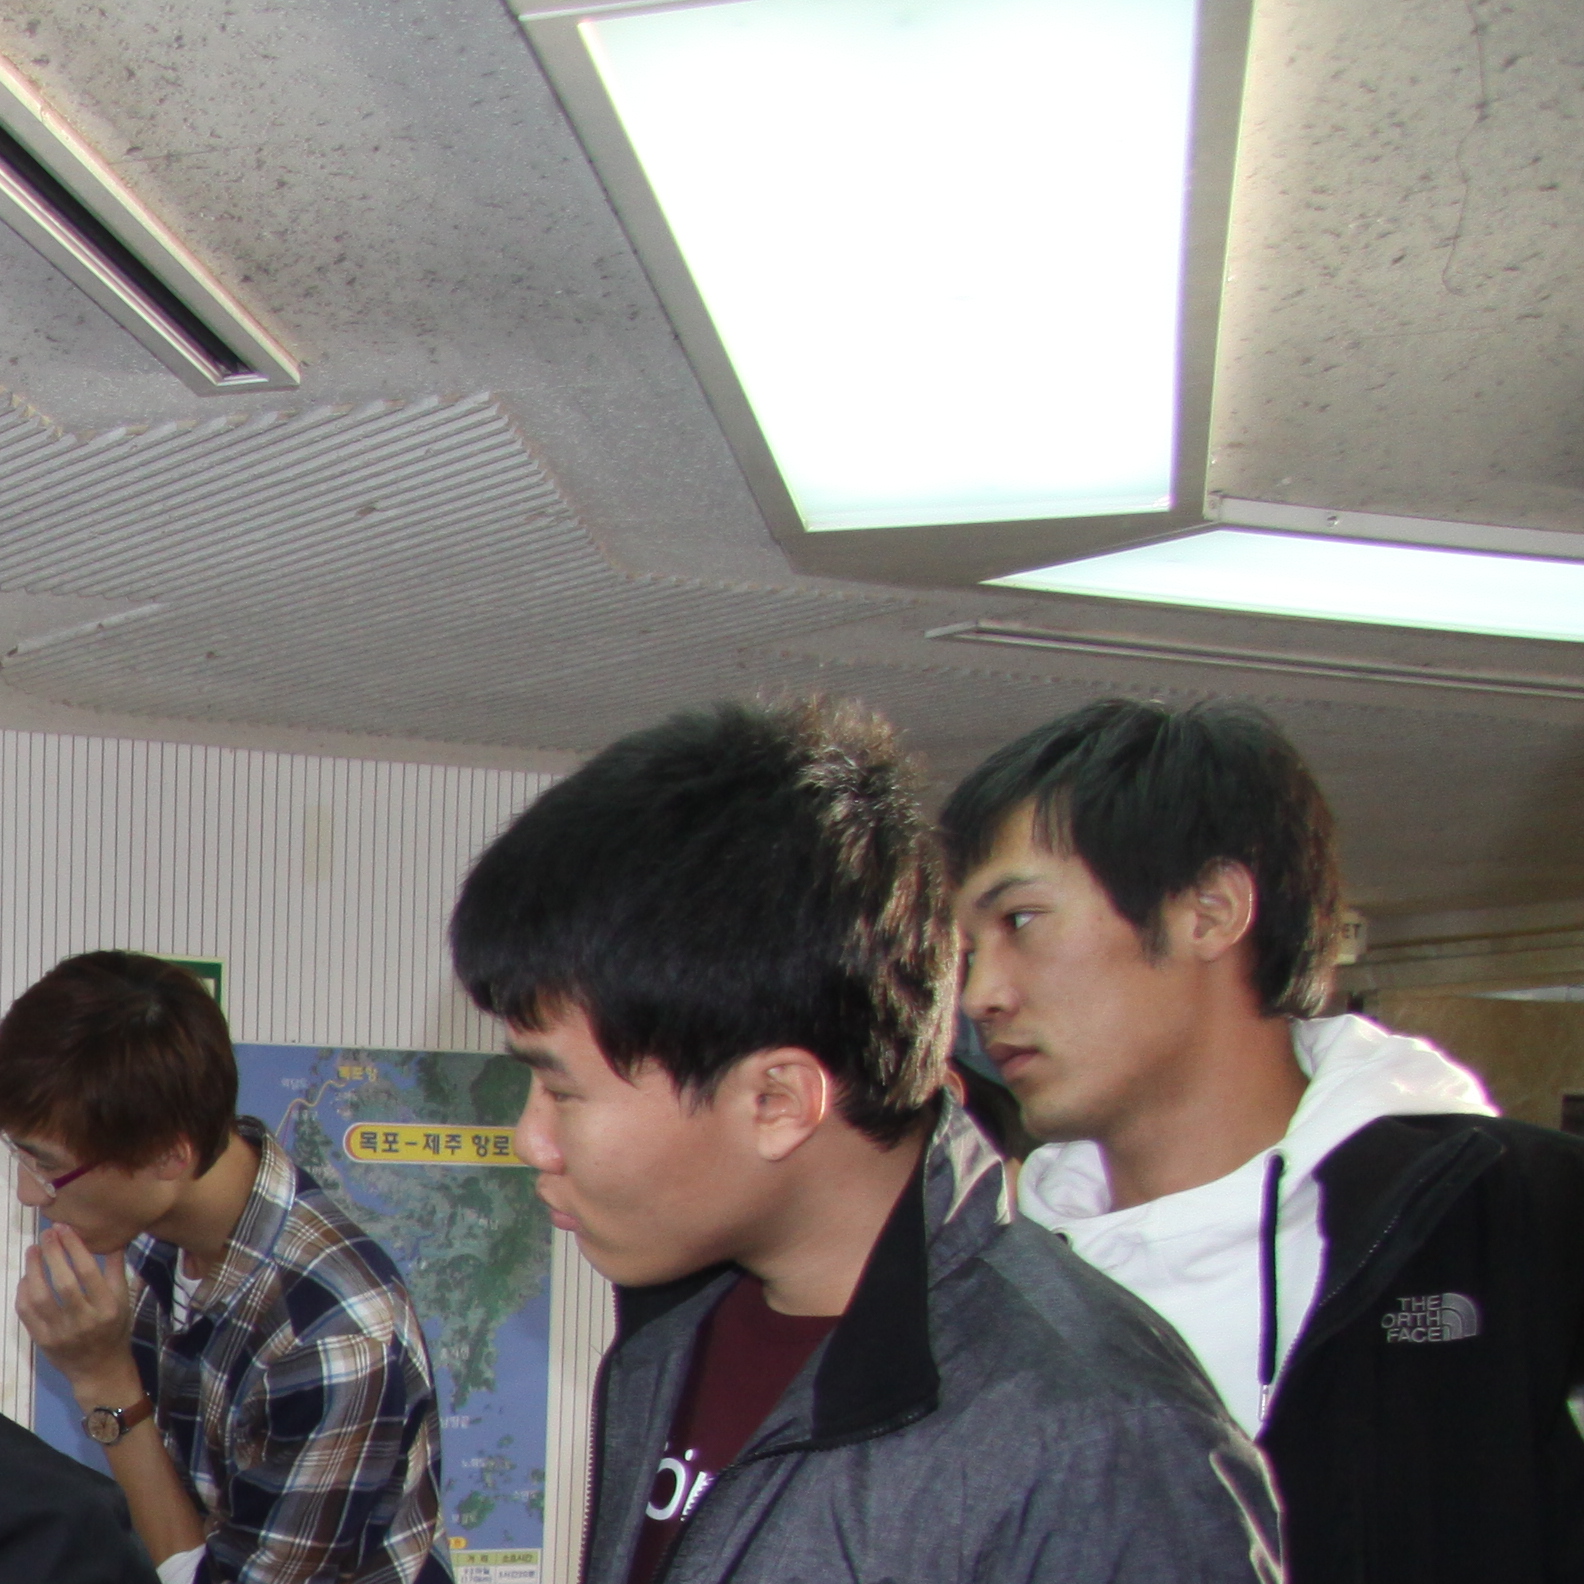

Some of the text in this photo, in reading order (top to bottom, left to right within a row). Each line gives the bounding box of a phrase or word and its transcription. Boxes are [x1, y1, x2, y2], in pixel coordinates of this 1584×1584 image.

[471, 1133, 512, 1158] 항로
[1396, 1294, 1442, 1312] THE
[1380, 1310, 1441, 1329] ORTH
[1386, 1326, 1443, 1343] FACE
